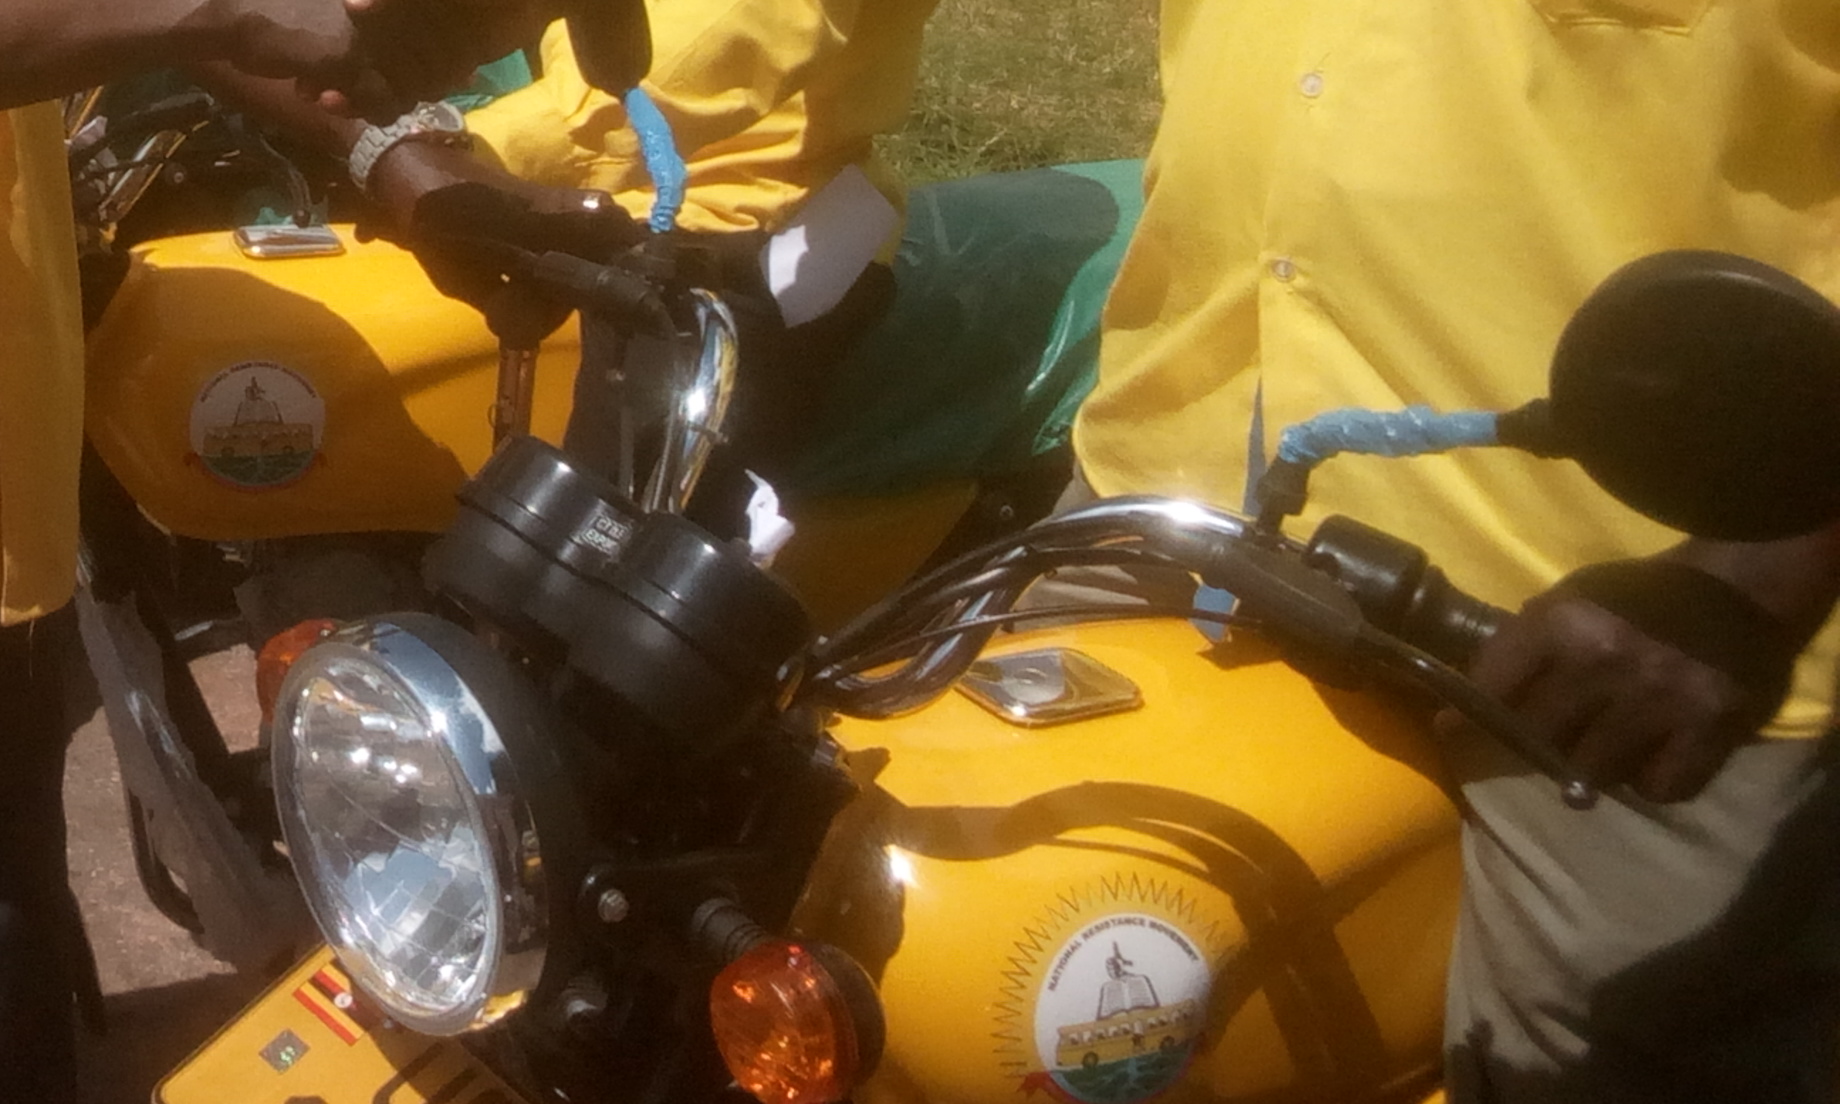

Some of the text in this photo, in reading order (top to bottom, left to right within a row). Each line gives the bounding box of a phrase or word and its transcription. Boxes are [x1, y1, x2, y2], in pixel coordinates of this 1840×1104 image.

[1047, 916, 1200, 992] NATIONAL RESISTANCE MOVEMENT
